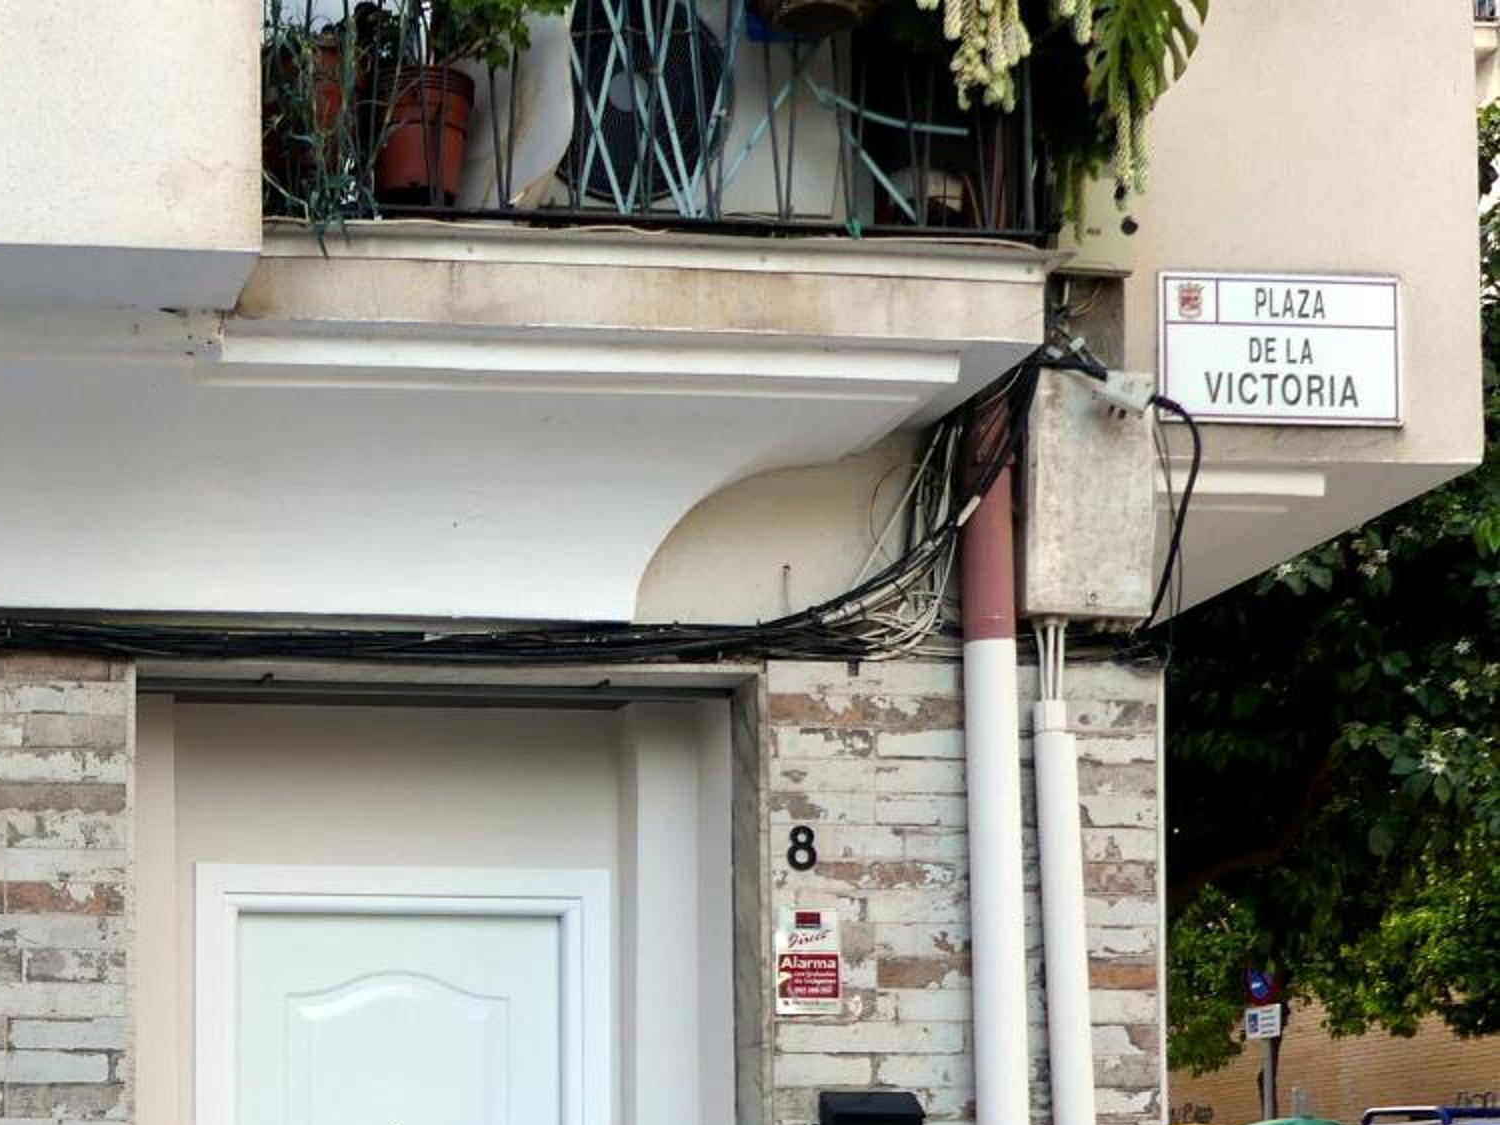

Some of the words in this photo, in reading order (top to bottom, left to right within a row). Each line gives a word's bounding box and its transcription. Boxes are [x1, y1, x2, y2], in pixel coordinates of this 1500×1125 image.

[1255, 288, 1326, 319] PLAZA
[1249, 337, 1276, 363] DE
[1286, 338, 1314, 365] LA
[1204, 371, 1359, 408] VICTORIA
[787, 825, 817, 871] 8
[781, 956, 837, 969] Alarma
